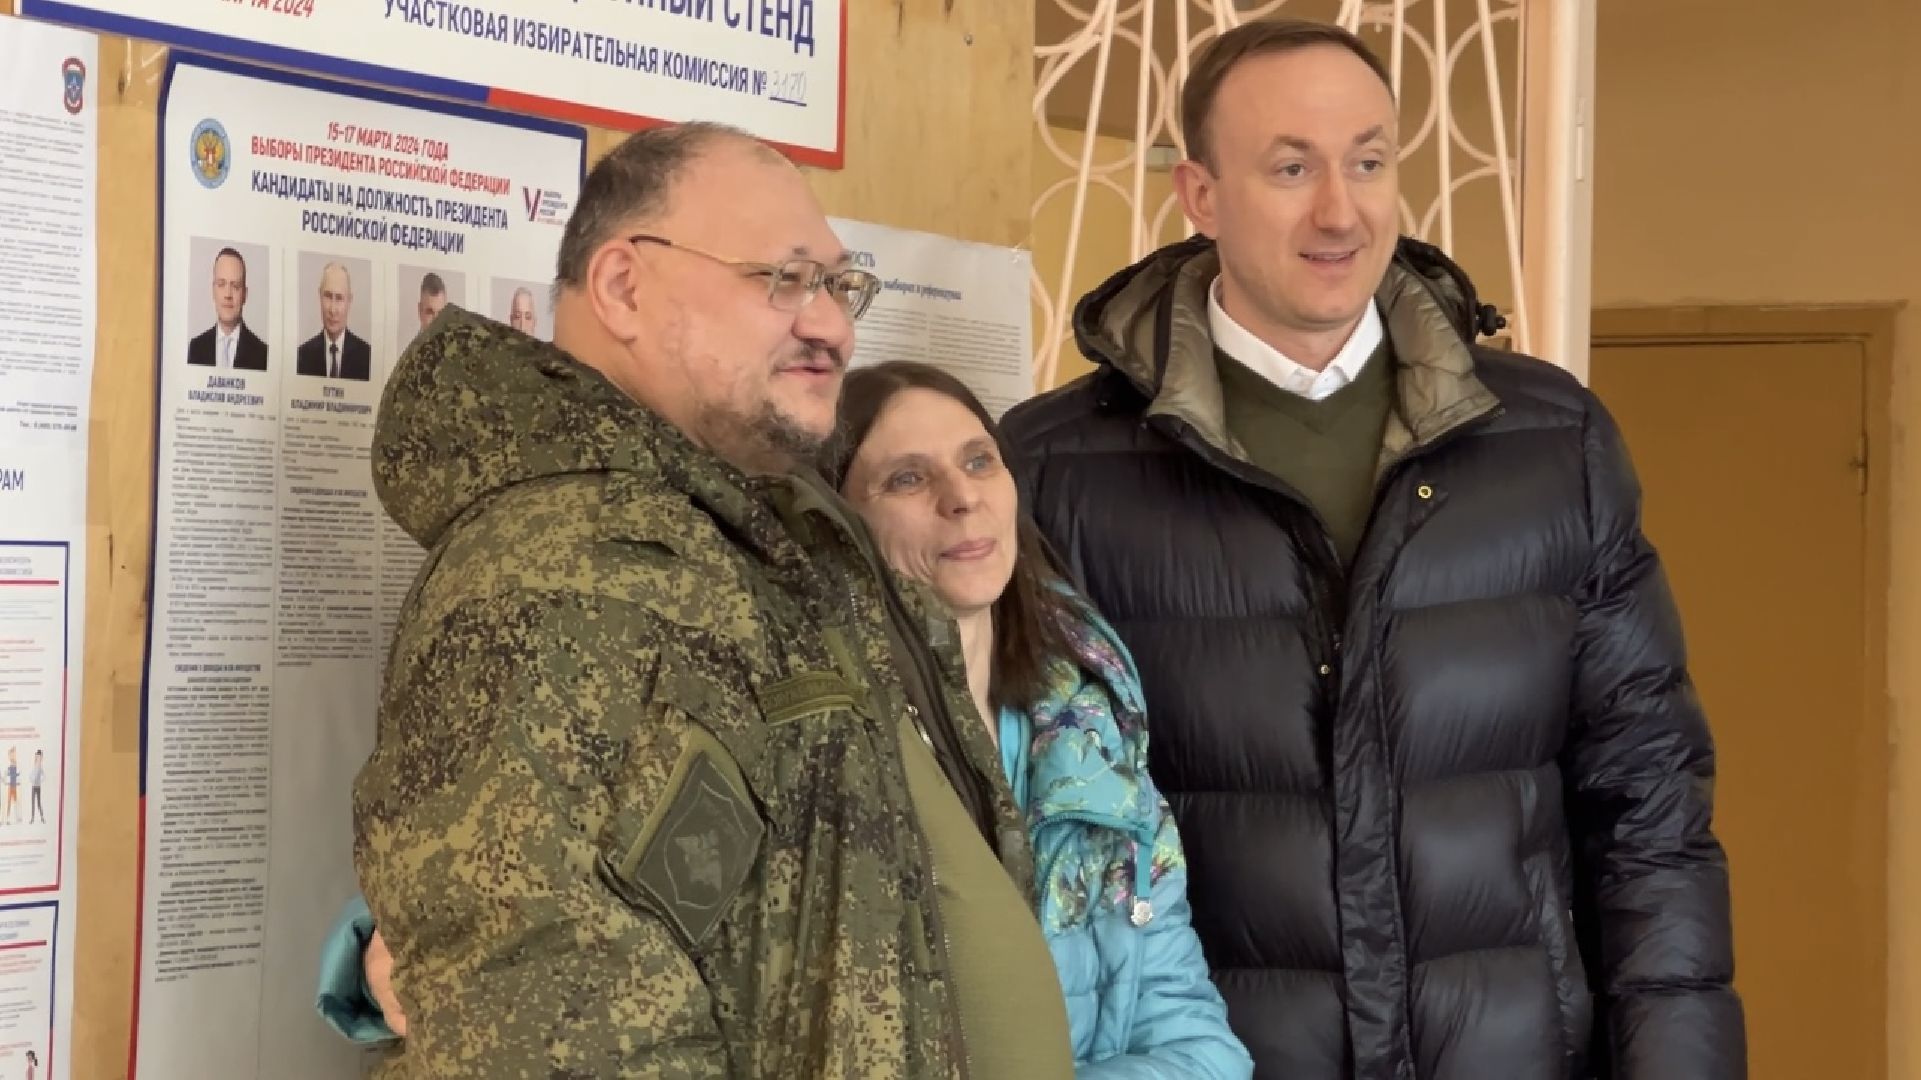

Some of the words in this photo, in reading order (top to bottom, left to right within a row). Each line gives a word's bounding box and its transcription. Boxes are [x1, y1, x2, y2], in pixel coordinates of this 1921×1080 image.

[384, 0, 508, 43] УЧАСТКОВАЯ
[512, 21, 659, 74] ИЗБИРАТЕЛЬНАЯ
[662, 49, 749, 93] КОМИССИЯ
[751, 70, 768, 96] №
[724, 0, 814, 57] СТЕНД
[251, 135, 303, 162] ВЫБОРЫ
[305, 144, 376, 174] ПРЕЗИДЕНТА
[378, 159, 448, 186] РОССИЙСКОЙ
[450, 168, 511, 196] ФЕДЕРАЦИИ
[357, 130, 392, 151] МАРТА
[394, 133, 419, 156] 2024
[422, 138, 449, 161] ГОДА
[251, 170, 334, 202] КАНДИДАТЫ
[337, 184, 354, 205] НА
[356, 186, 433, 219] ДОЛЖНОСТЬ
[435, 199, 509, 231] ПРЕЗИДЕНТА
[302, 208, 388, 243] РОССИЙСКОЙ
[390, 222, 465, 255] ФЕДЕРАЦИИ
